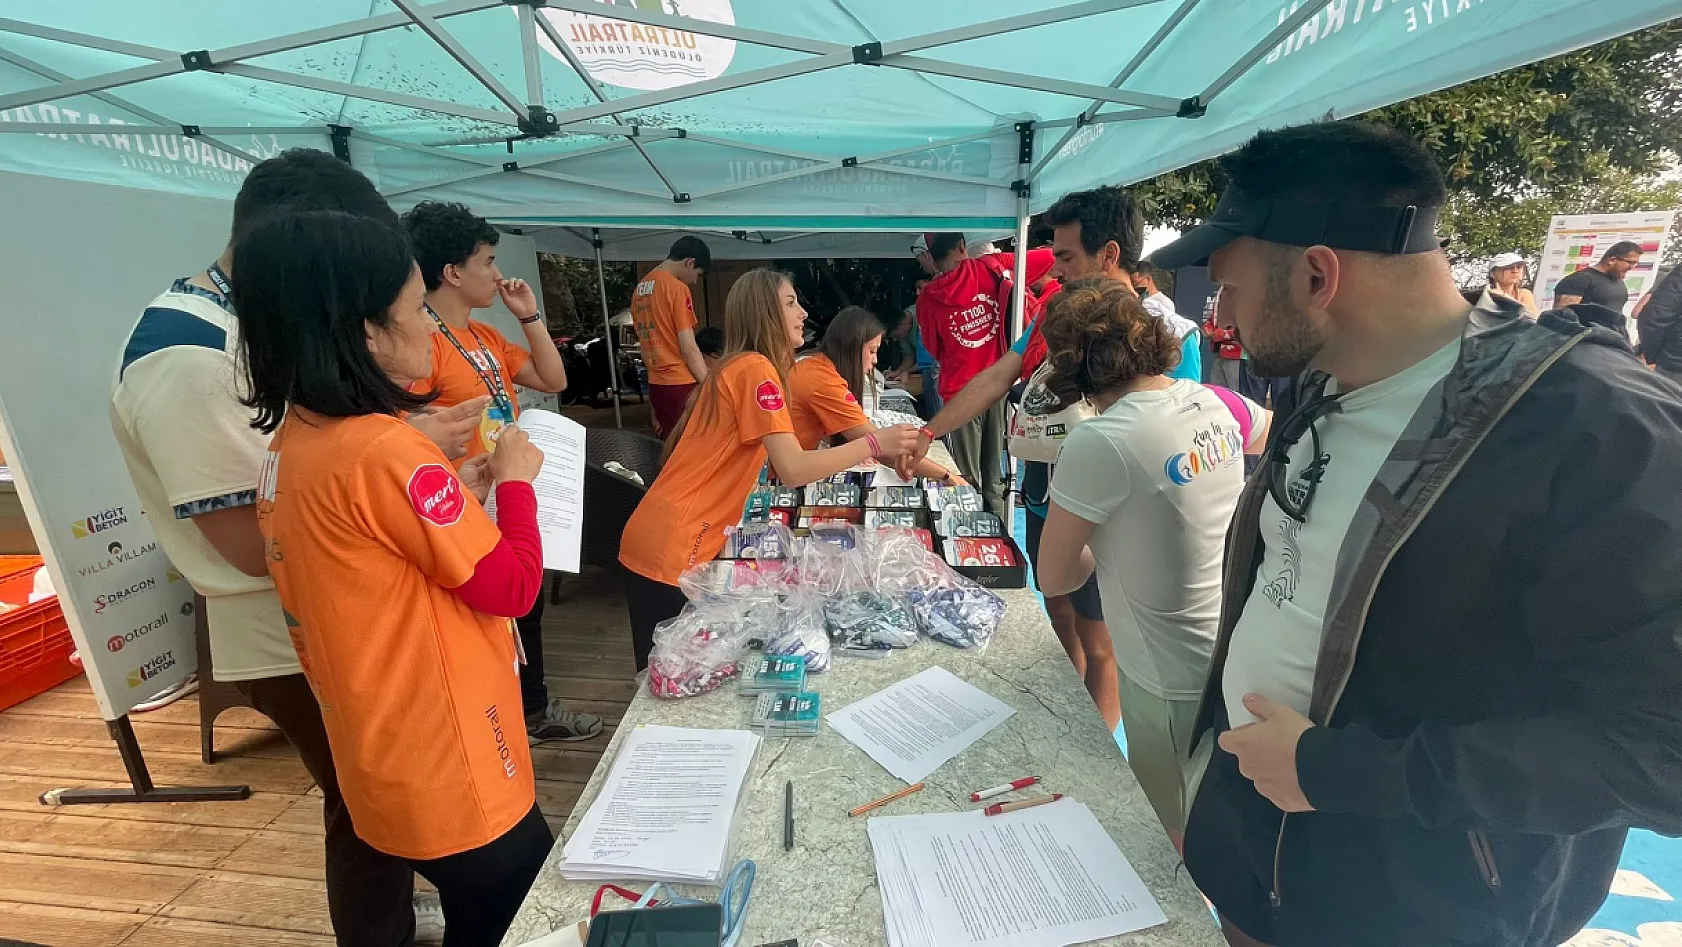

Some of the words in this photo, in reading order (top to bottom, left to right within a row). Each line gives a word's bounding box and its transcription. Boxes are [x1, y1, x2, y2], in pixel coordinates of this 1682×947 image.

[959, 313, 993, 334] FINISHER
[95, 516, 128, 532] BETON
[78, 558, 114, 577] VILLA
[116, 542, 157, 563] VILLAM
[107, 576, 156, 603] DRAGON
[107, 612, 169, 652] motorall
[485, 704, 516, 779] motorall
